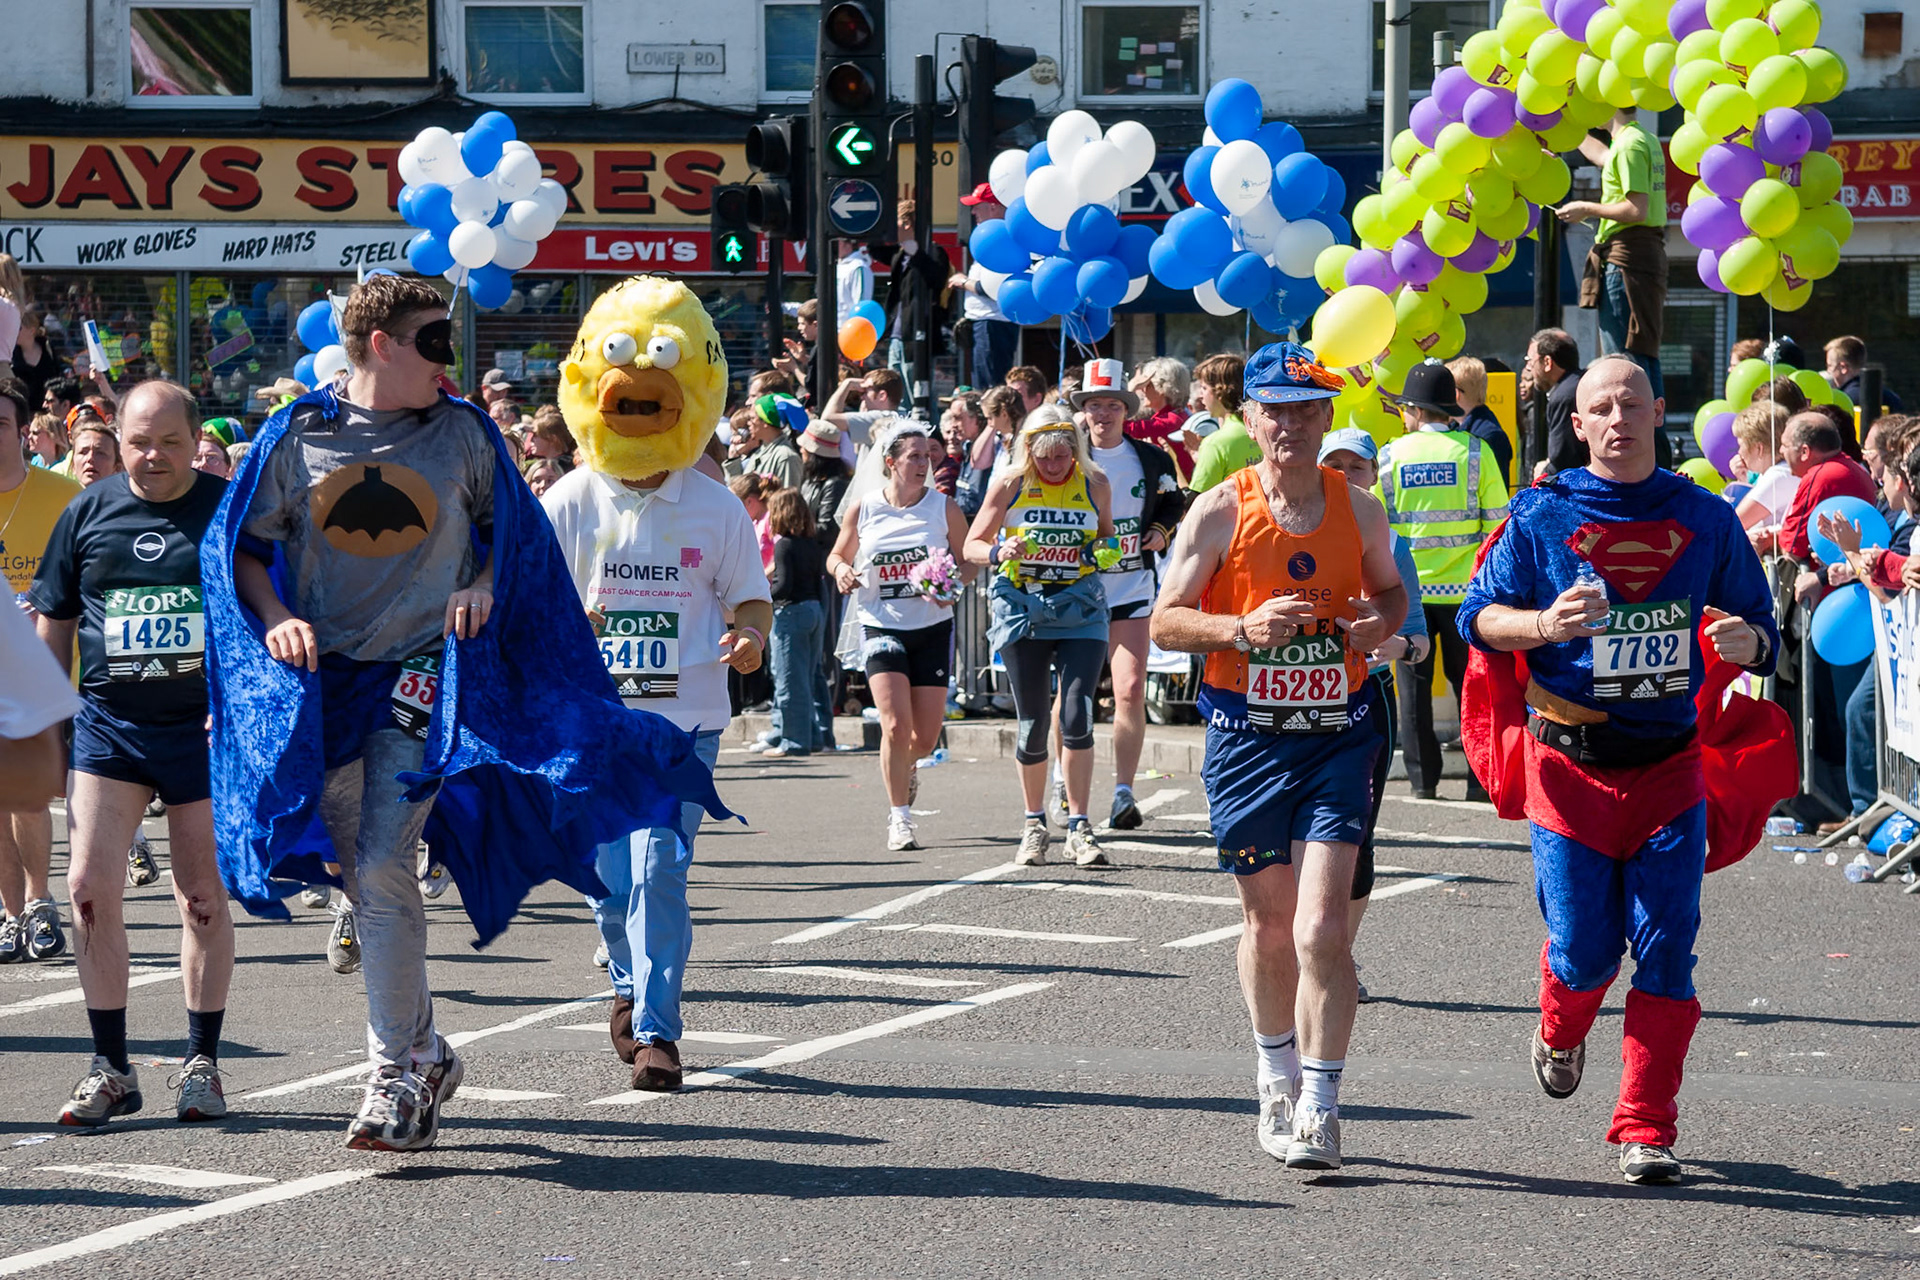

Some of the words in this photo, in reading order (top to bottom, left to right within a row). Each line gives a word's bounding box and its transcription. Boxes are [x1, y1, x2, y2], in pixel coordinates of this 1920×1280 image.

[634, 51, 686, 66] LOWER
[694, 51, 720, 66] RD.
[6, 144, 263, 212] JAYS
[294, 146, 726, 215] STRES
[1840, 184, 1912, 208] BAB
[0, 227, 45, 263] CK
[77, 236, 128, 264] WORK
[133, 227, 197, 255] GLOVES
[222, 236, 268, 262] HARD
[270, 230, 316, 256] HATS
[340, 242, 397, 267] STEEL
[585, 236, 698, 262] Levi's
[1090, 361, 1112, 386] L
[1404, 471, 1454, 487] POLICE
[1024, 509, 1087, 526] GILLY
[1113, 519, 1138, 534] ORA
[0, 556, 43, 570] IGH
[874, 547, 926, 564] FLORA
[604, 562, 680, 582] HOMER
[104, 587, 199, 614] FLORA
[618, 588, 650, 597] CANCER
[121, 616, 192, 650] 1425
[604, 612, 672, 636] LORA
[601, 640, 667, 669] 5410
[1267, 637, 1341, 665] LORA
[1607, 633, 1680, 671] 7782
[1252, 667, 1342, 701] 45282
[1630, 690, 1660, 699] adidas
[1281, 721, 1312, 731] adidas
